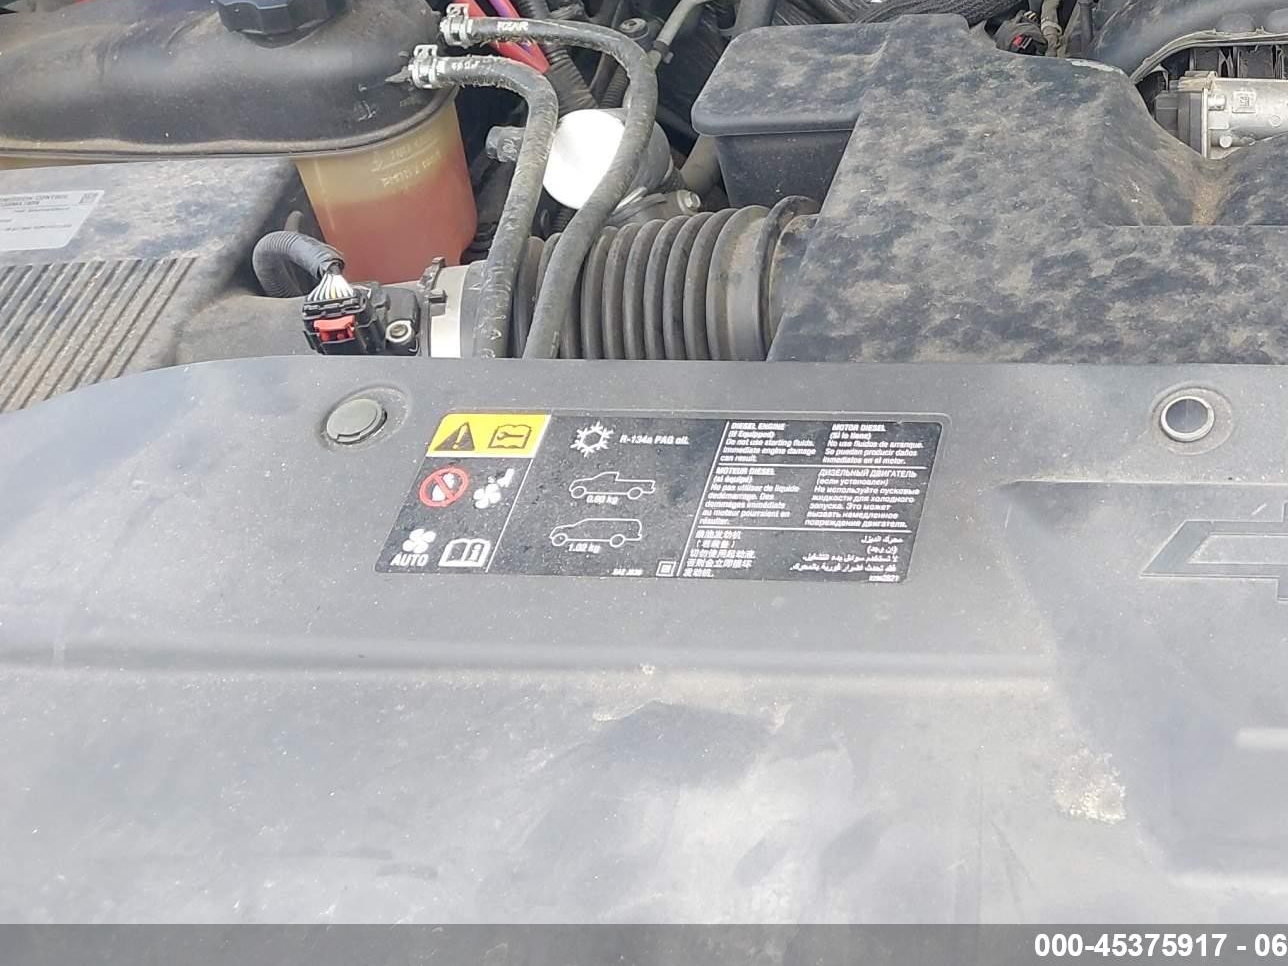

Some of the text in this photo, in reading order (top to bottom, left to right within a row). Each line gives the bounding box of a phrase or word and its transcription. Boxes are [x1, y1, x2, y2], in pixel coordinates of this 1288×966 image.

[860, 424, 886, 432] DIESEL
[620, 435, 653, 444] R-134a
[654, 435, 674, 444] PAG
[787, 448, 816, 456] damage
[864, 449, 894, 457] producir
[749, 467, 776, 475] DIESEL
[818, 469, 918, 478] ДИЗЕЛЬНЫЙ ДВИГАТЕЛЬ
[826, 486, 879, 495] используйте
[606, 495, 619, 505] kg
[705, 501, 745, 509] dommages
[846, 502, 862, 510] Это
[568, 543, 601, 554] 1.02 kg
[390, 553, 429, 566] AUTO
